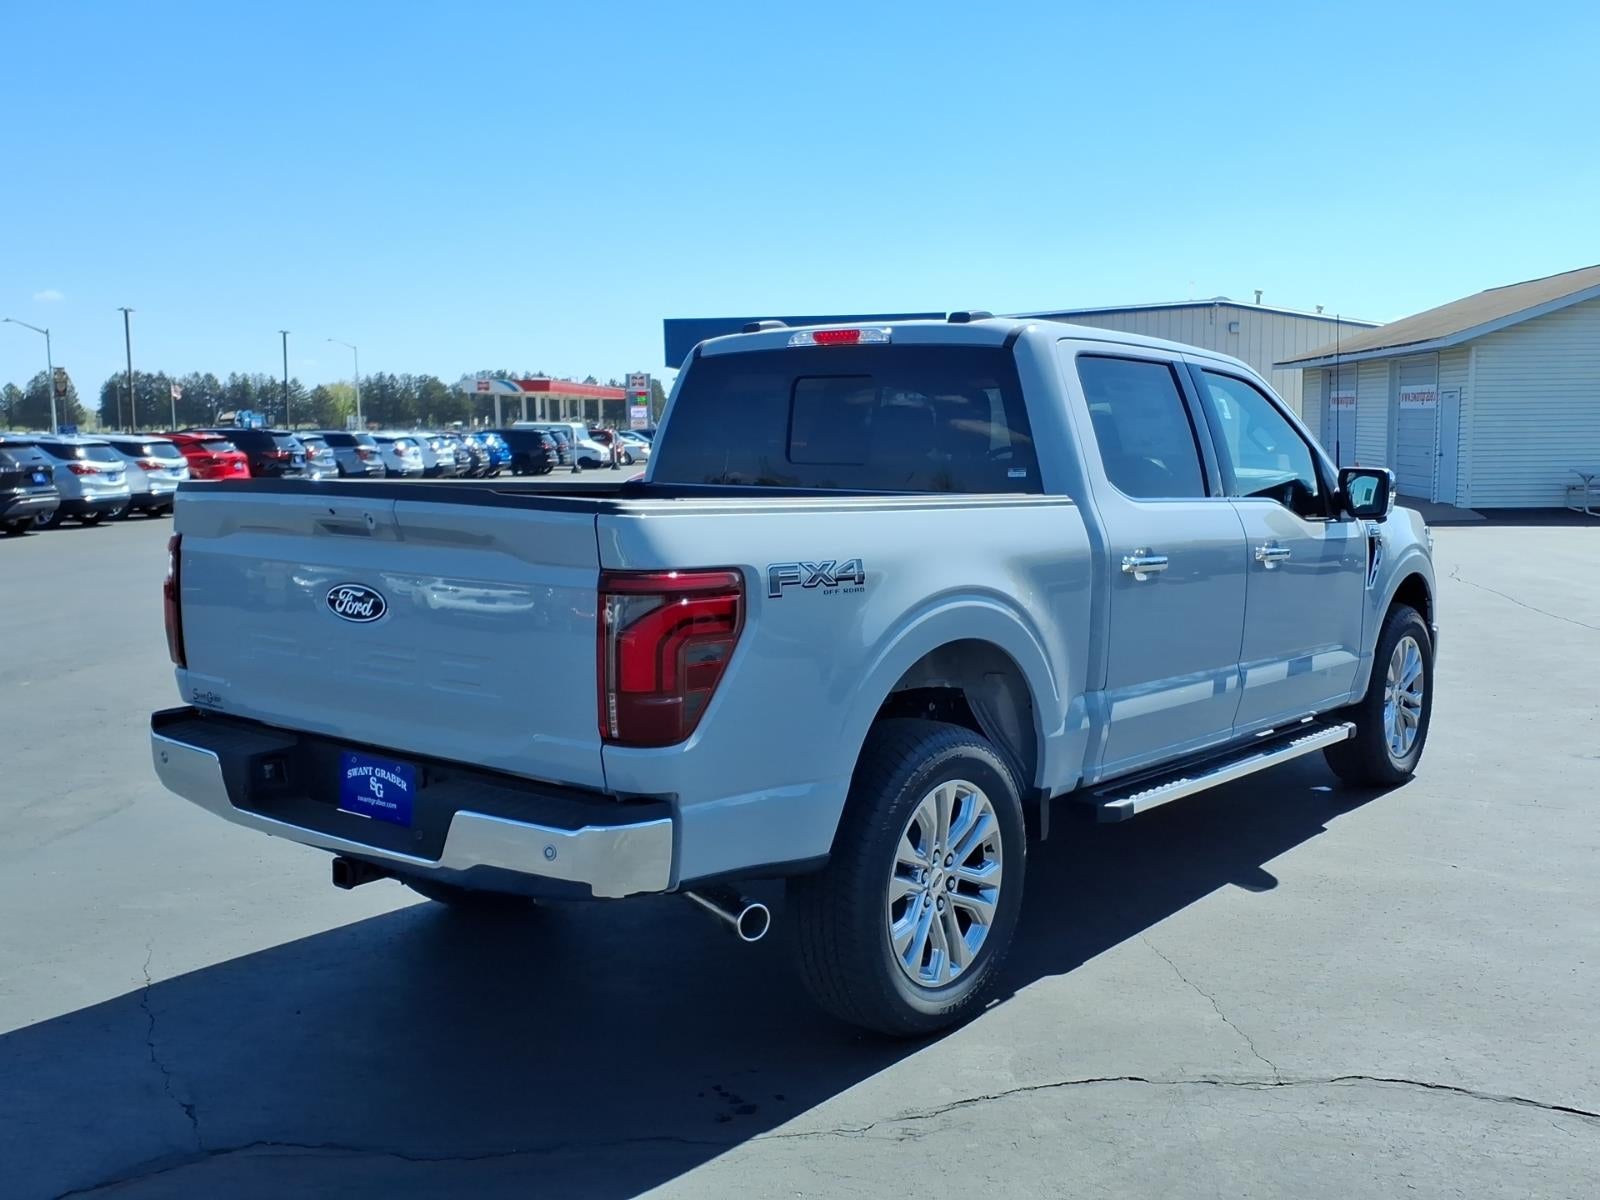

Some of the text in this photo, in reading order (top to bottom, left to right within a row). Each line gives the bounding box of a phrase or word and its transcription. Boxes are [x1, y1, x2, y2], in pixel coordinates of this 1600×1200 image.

[766, 558, 865, 598] FX4
[335, 588, 374, 616] Ford
[347, 766, 407, 792] SWANT GRABER
